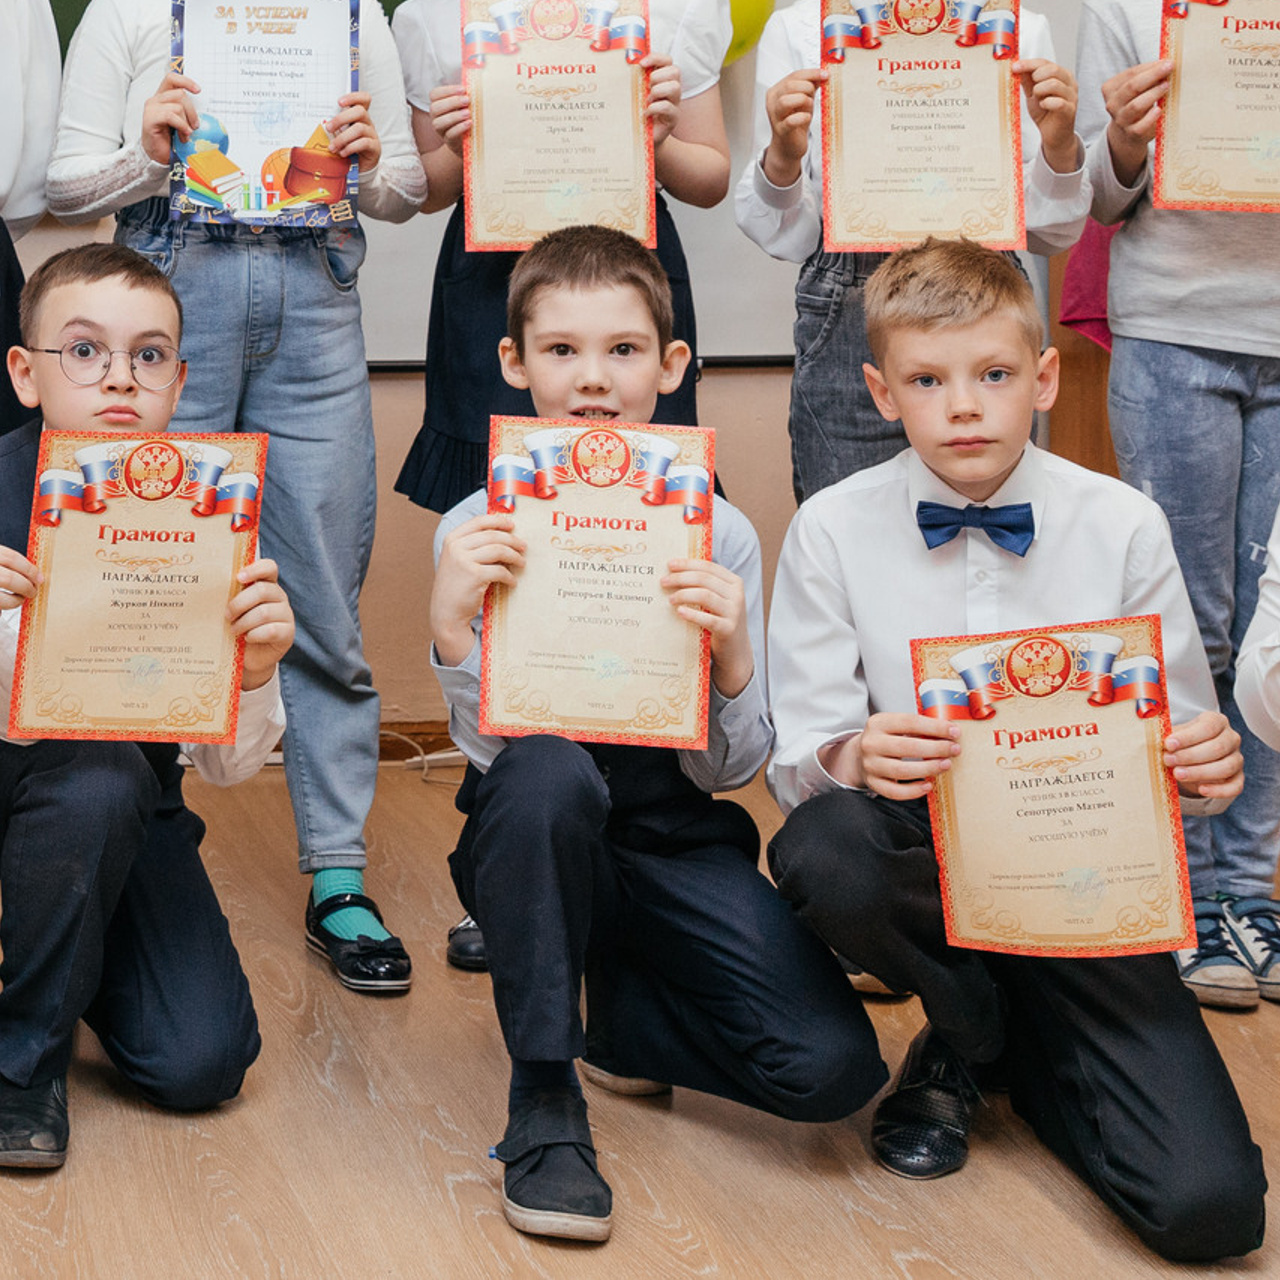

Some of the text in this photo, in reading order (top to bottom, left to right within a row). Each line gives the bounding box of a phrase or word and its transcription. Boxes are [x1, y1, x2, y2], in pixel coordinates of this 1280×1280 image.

[215, 6, 309, 19] ЗА УСПЕХИ
[225, 22, 237, 34] В
[233, 45, 313, 56] НАГРАЖДАЕТСЯ
[516, 63, 597, 79] Грамота
[877, 58, 961, 75] Грамота
[525, 101, 605, 110] НАГРАЖДАЕТСЯ
[885, 99, 970, 107] НАГРАЖДАЕТСЯ
[552, 511, 647, 532] Грамота
[98, 525, 196, 545] Грамота
[559, 560, 654, 575] НАГРАЖДАЕТСЯ
[102, 572, 199, 584] НАГРАЖДАЕТСЯ
[993, 722, 1099, 750] Грамота
[1010, 770, 1114, 790] НАГРАЖДАЕТСЯ
[1029, 831, 1078, 843] ХОРОШУЮ
